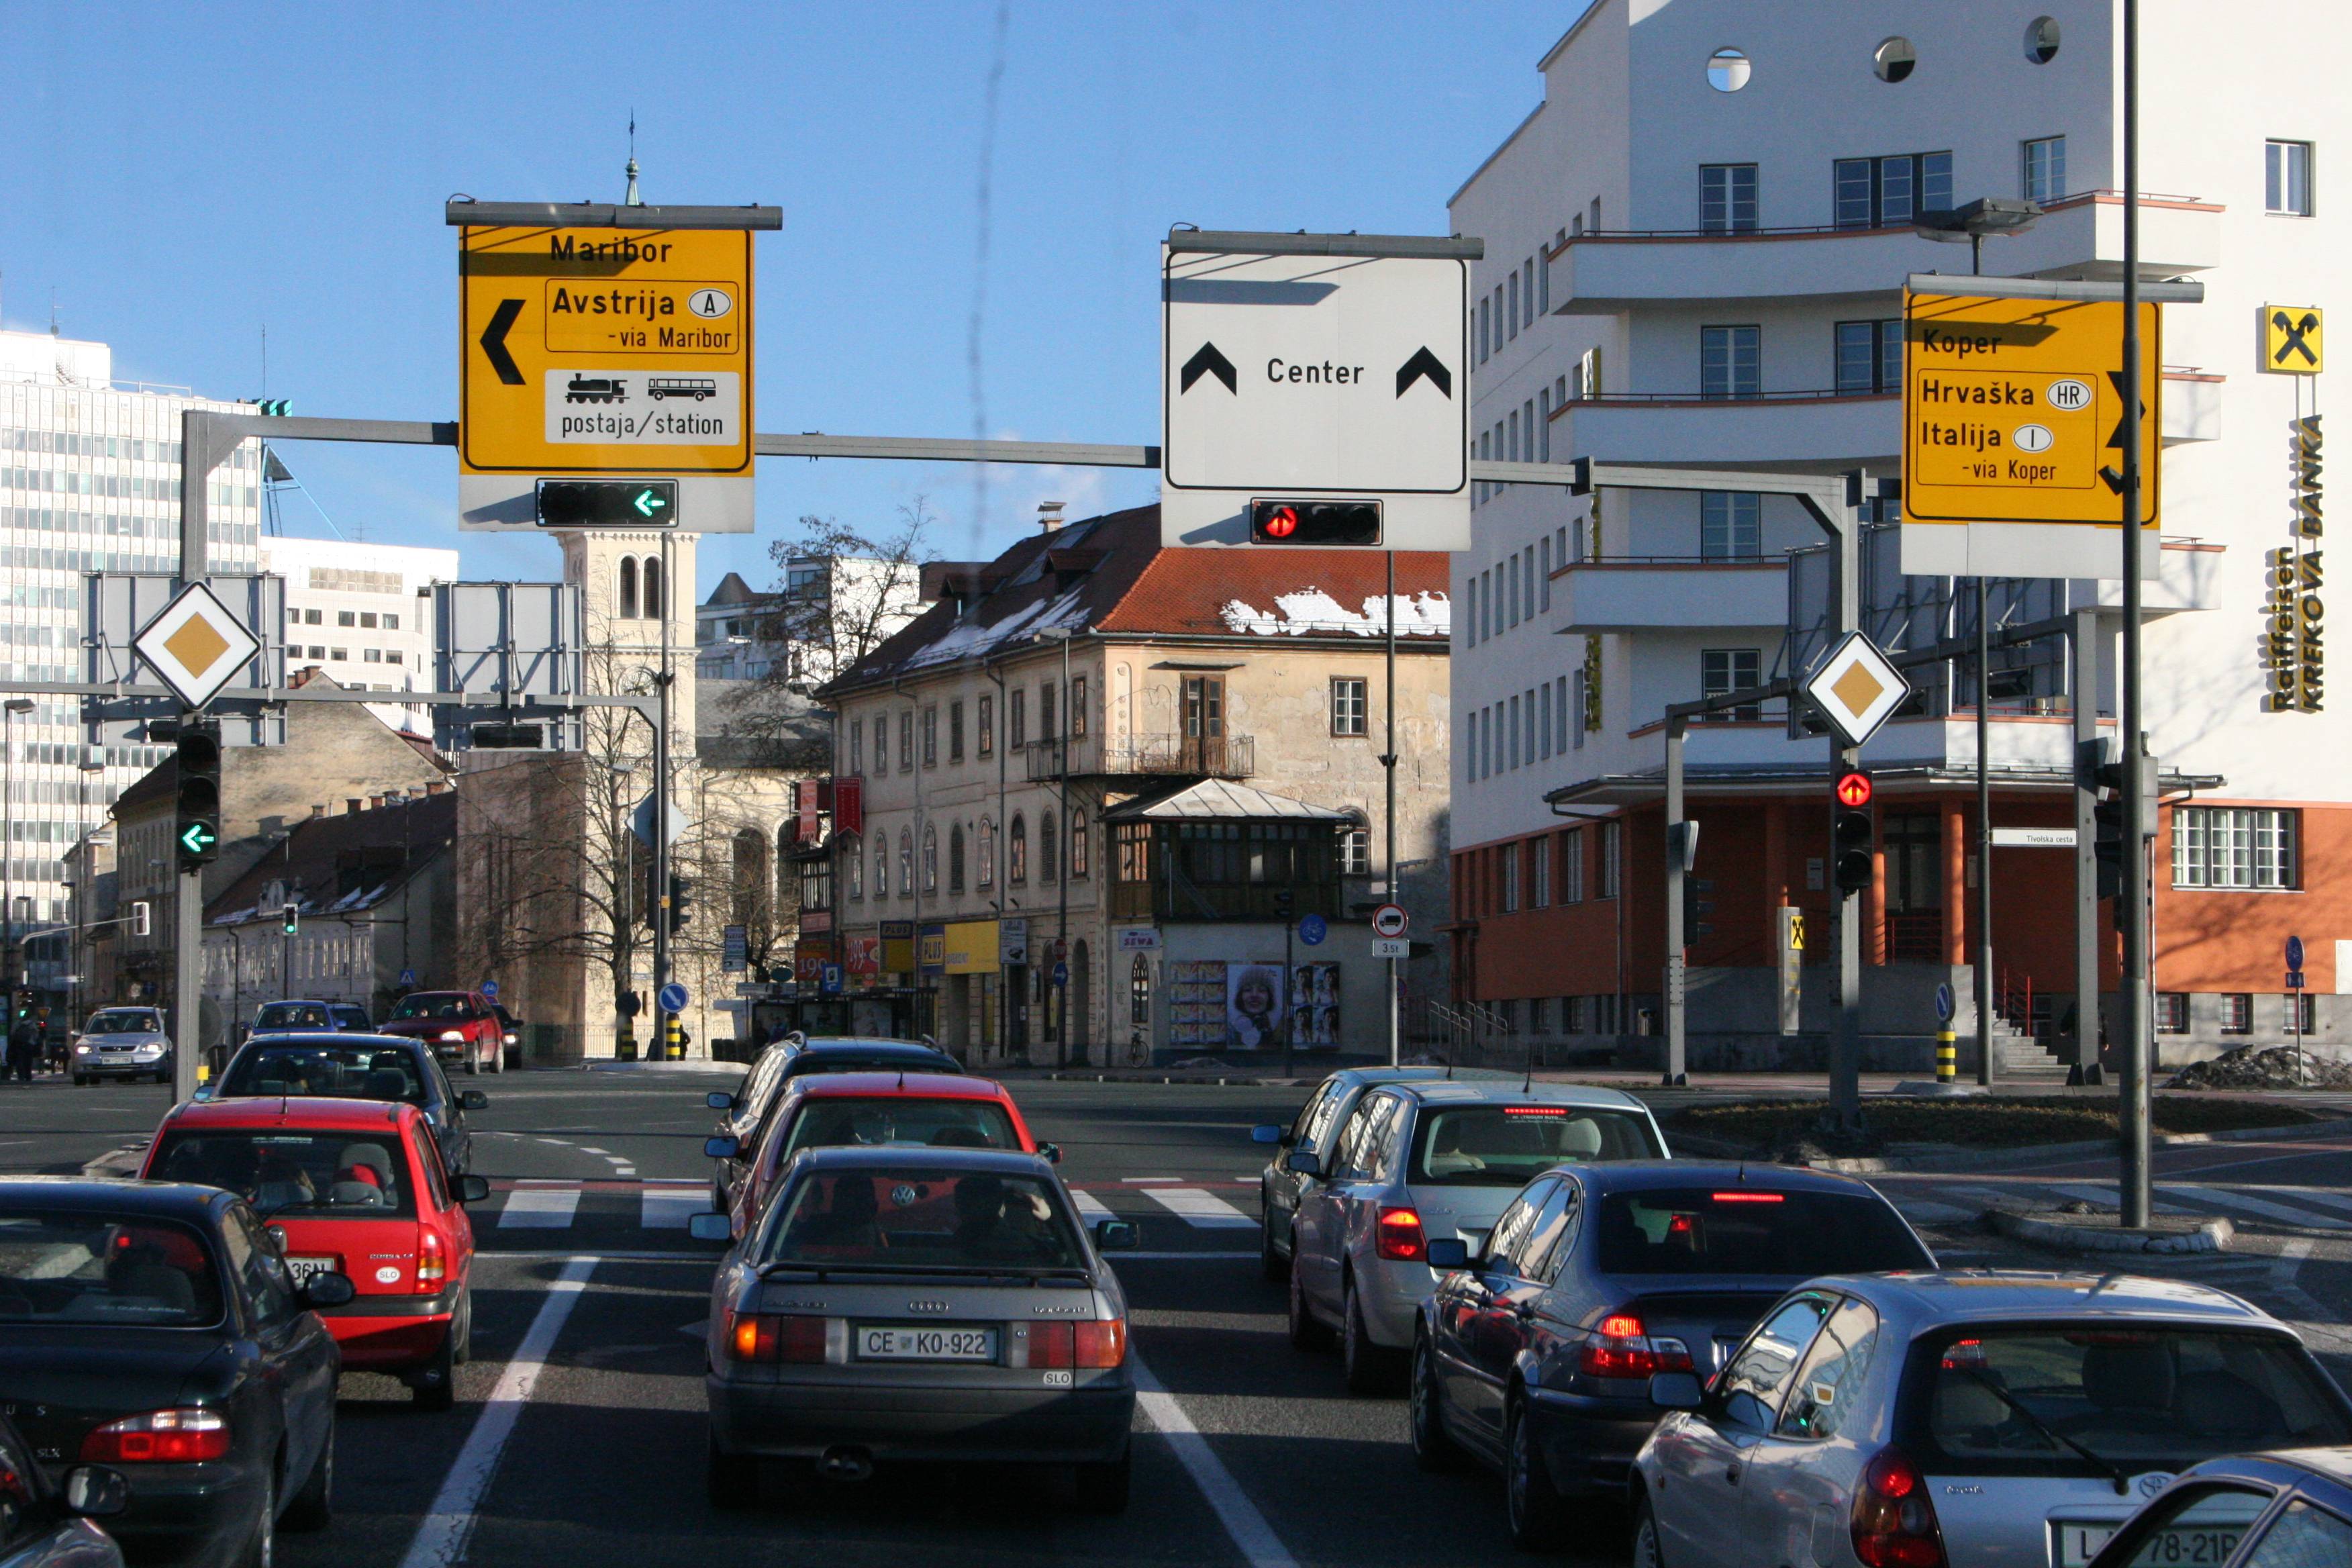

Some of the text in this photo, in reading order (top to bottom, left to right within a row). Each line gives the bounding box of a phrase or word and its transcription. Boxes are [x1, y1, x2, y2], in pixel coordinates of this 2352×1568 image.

[550, 235, 672, 262] Maribor
[552, 287, 716, 322] Avstrija A
[659, 328, 731, 348] Maribor
[1923, 328, 2002, 359] Koper
[1267, 358, 1365, 385] Center
[1922, 379, 2080, 405] Hrvaška HR
[562, 411, 724, 438] postaja/station
[1922, 422, 2001, 452] Italija
[2008, 459, 2057, 485] Koper
[2301, 413, 2324, 712] KREKOVA BANKA
[2269, 546, 2294, 710] Raiffeisen
[2026, 834, 2054, 843] Tivolska
[885, 925, 908, 934] PLUS
[379, 1271, 397, 1279] SLO
[868, 1332, 894, 1353] CE
[1046, 1373, 1071, 1384] SLO
